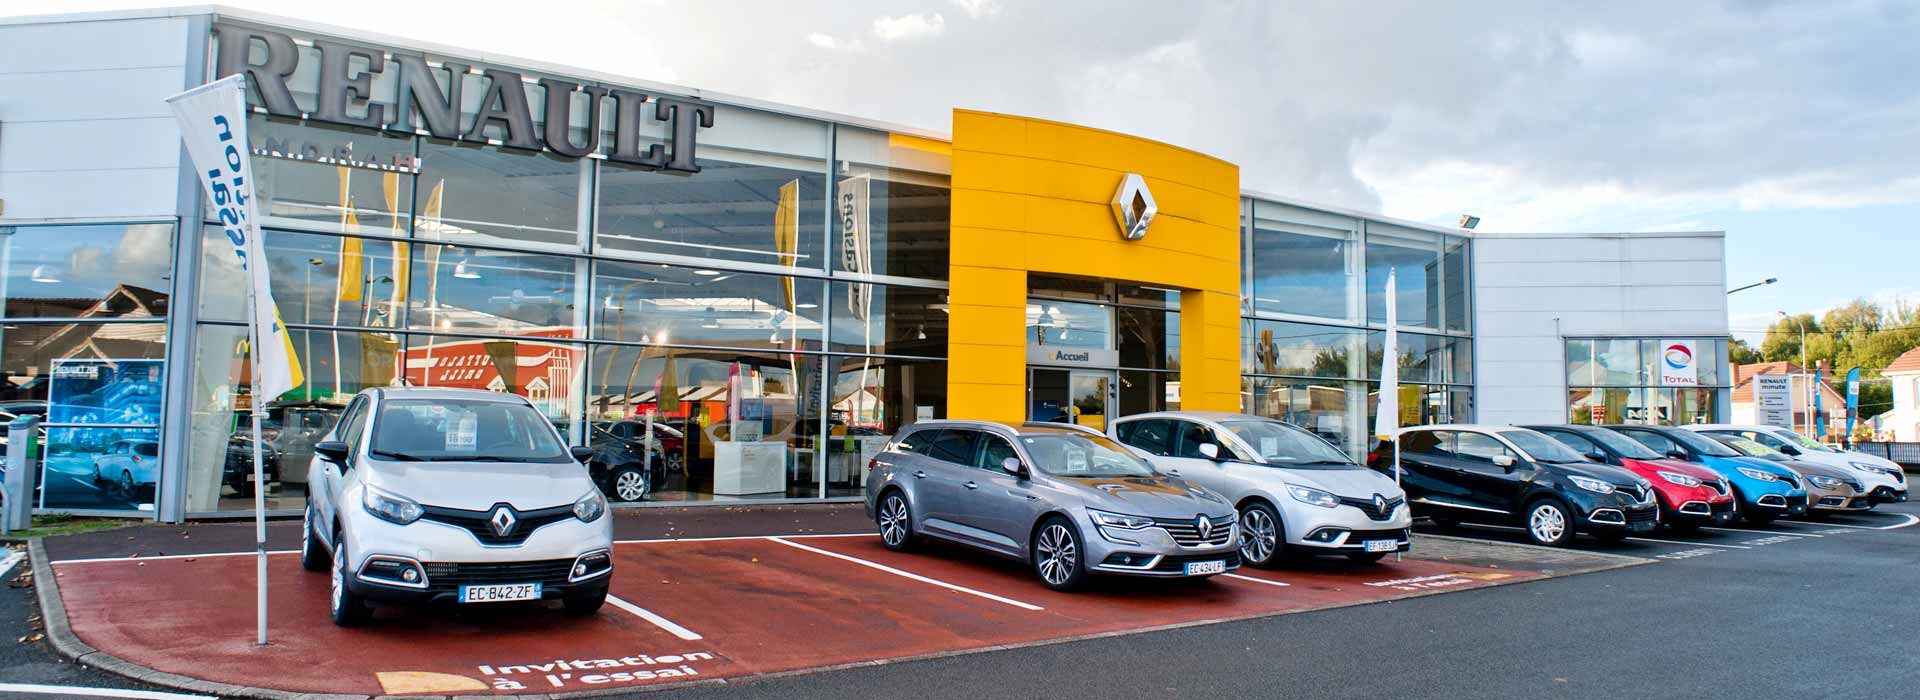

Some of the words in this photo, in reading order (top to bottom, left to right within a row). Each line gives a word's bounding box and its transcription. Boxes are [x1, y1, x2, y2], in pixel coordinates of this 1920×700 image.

[210, 26, 715, 173] RENAULT
[1056, 351, 1088, 361] Accueil
[1663, 375, 1695, 384] TOTAL
[478, 651, 712, 675] Invitation
